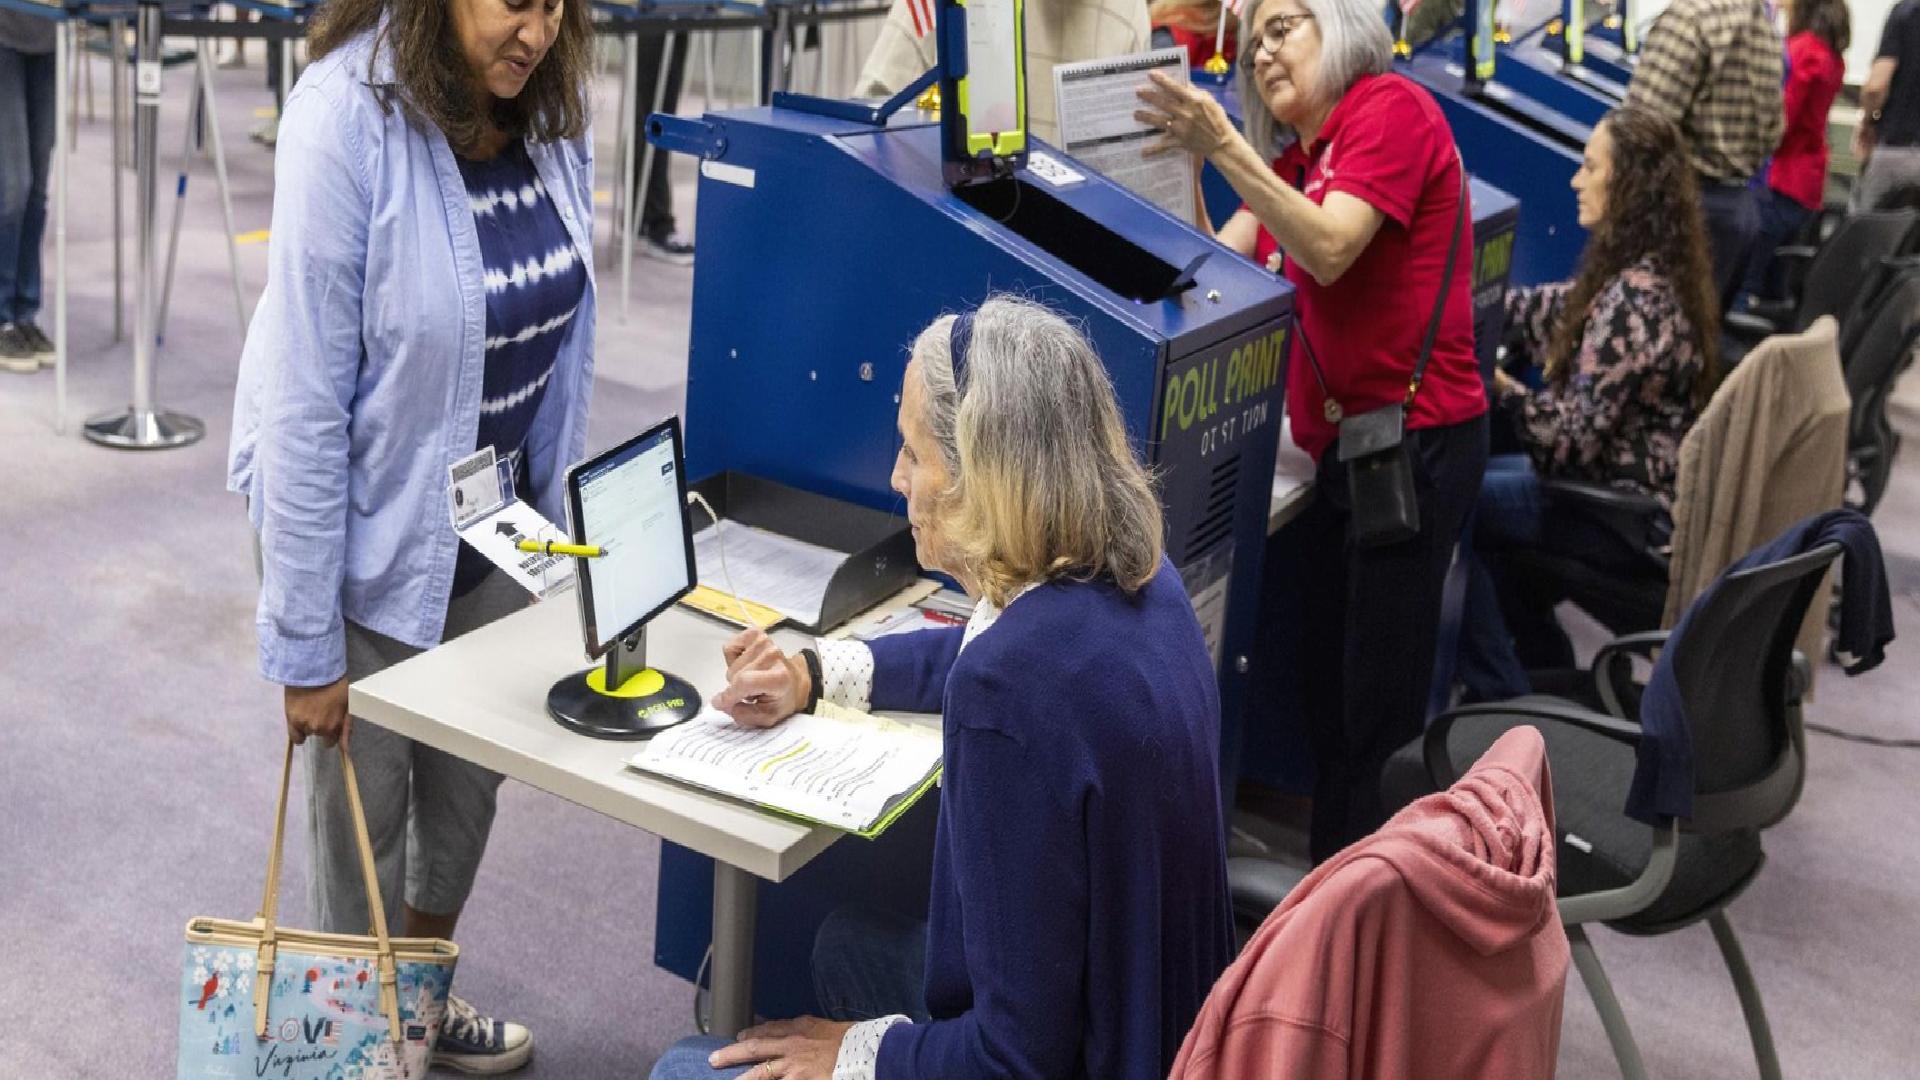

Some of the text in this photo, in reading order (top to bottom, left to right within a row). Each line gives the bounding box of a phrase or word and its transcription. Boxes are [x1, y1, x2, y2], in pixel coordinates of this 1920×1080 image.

[1162, 329, 1286, 440] POLL PRINT
[255, 1043, 338, 1078] Virginia
